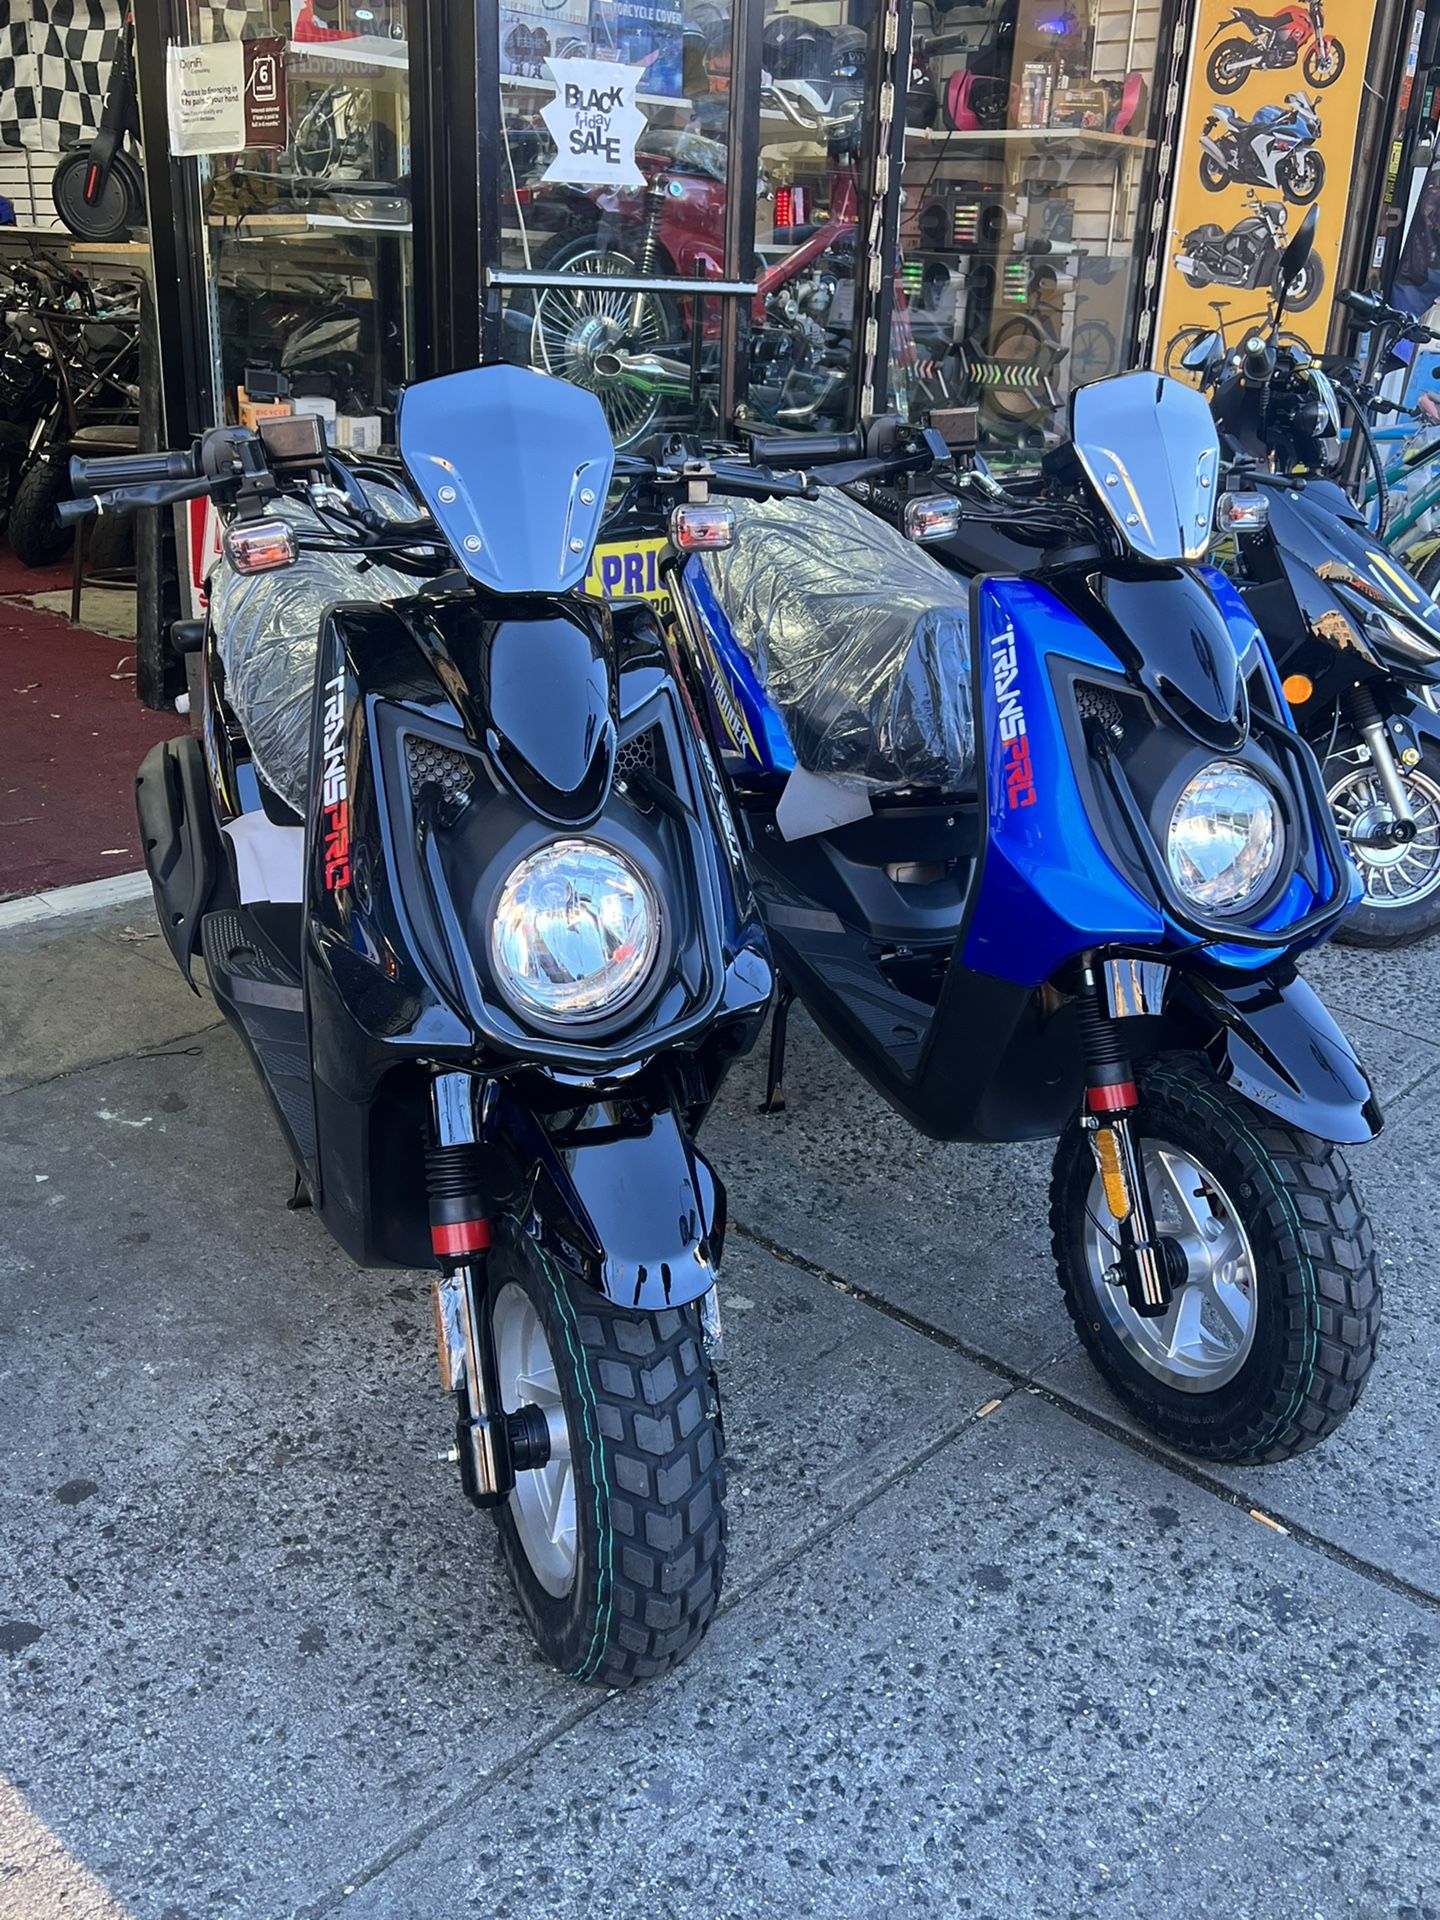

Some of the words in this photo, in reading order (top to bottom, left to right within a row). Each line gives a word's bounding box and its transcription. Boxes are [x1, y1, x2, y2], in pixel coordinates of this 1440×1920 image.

[655, 9, 682, 25] COVER
[259, 65, 268, 83] 6
[181, 89, 201, 97] Access
[207, 86, 231, 95] financing
[211, 97, 224, 106] your
[565, 83, 625, 115] BLACK
[575, 111, 612, 132] friday
[569, 126, 621, 164] SALE
[601, 550, 668, 598] PRI
[711, 668, 750, 758] THUNDER
[991, 620, 1037, 810] TRANSPRO
[323, 665, 351, 890] TRANSPRO
